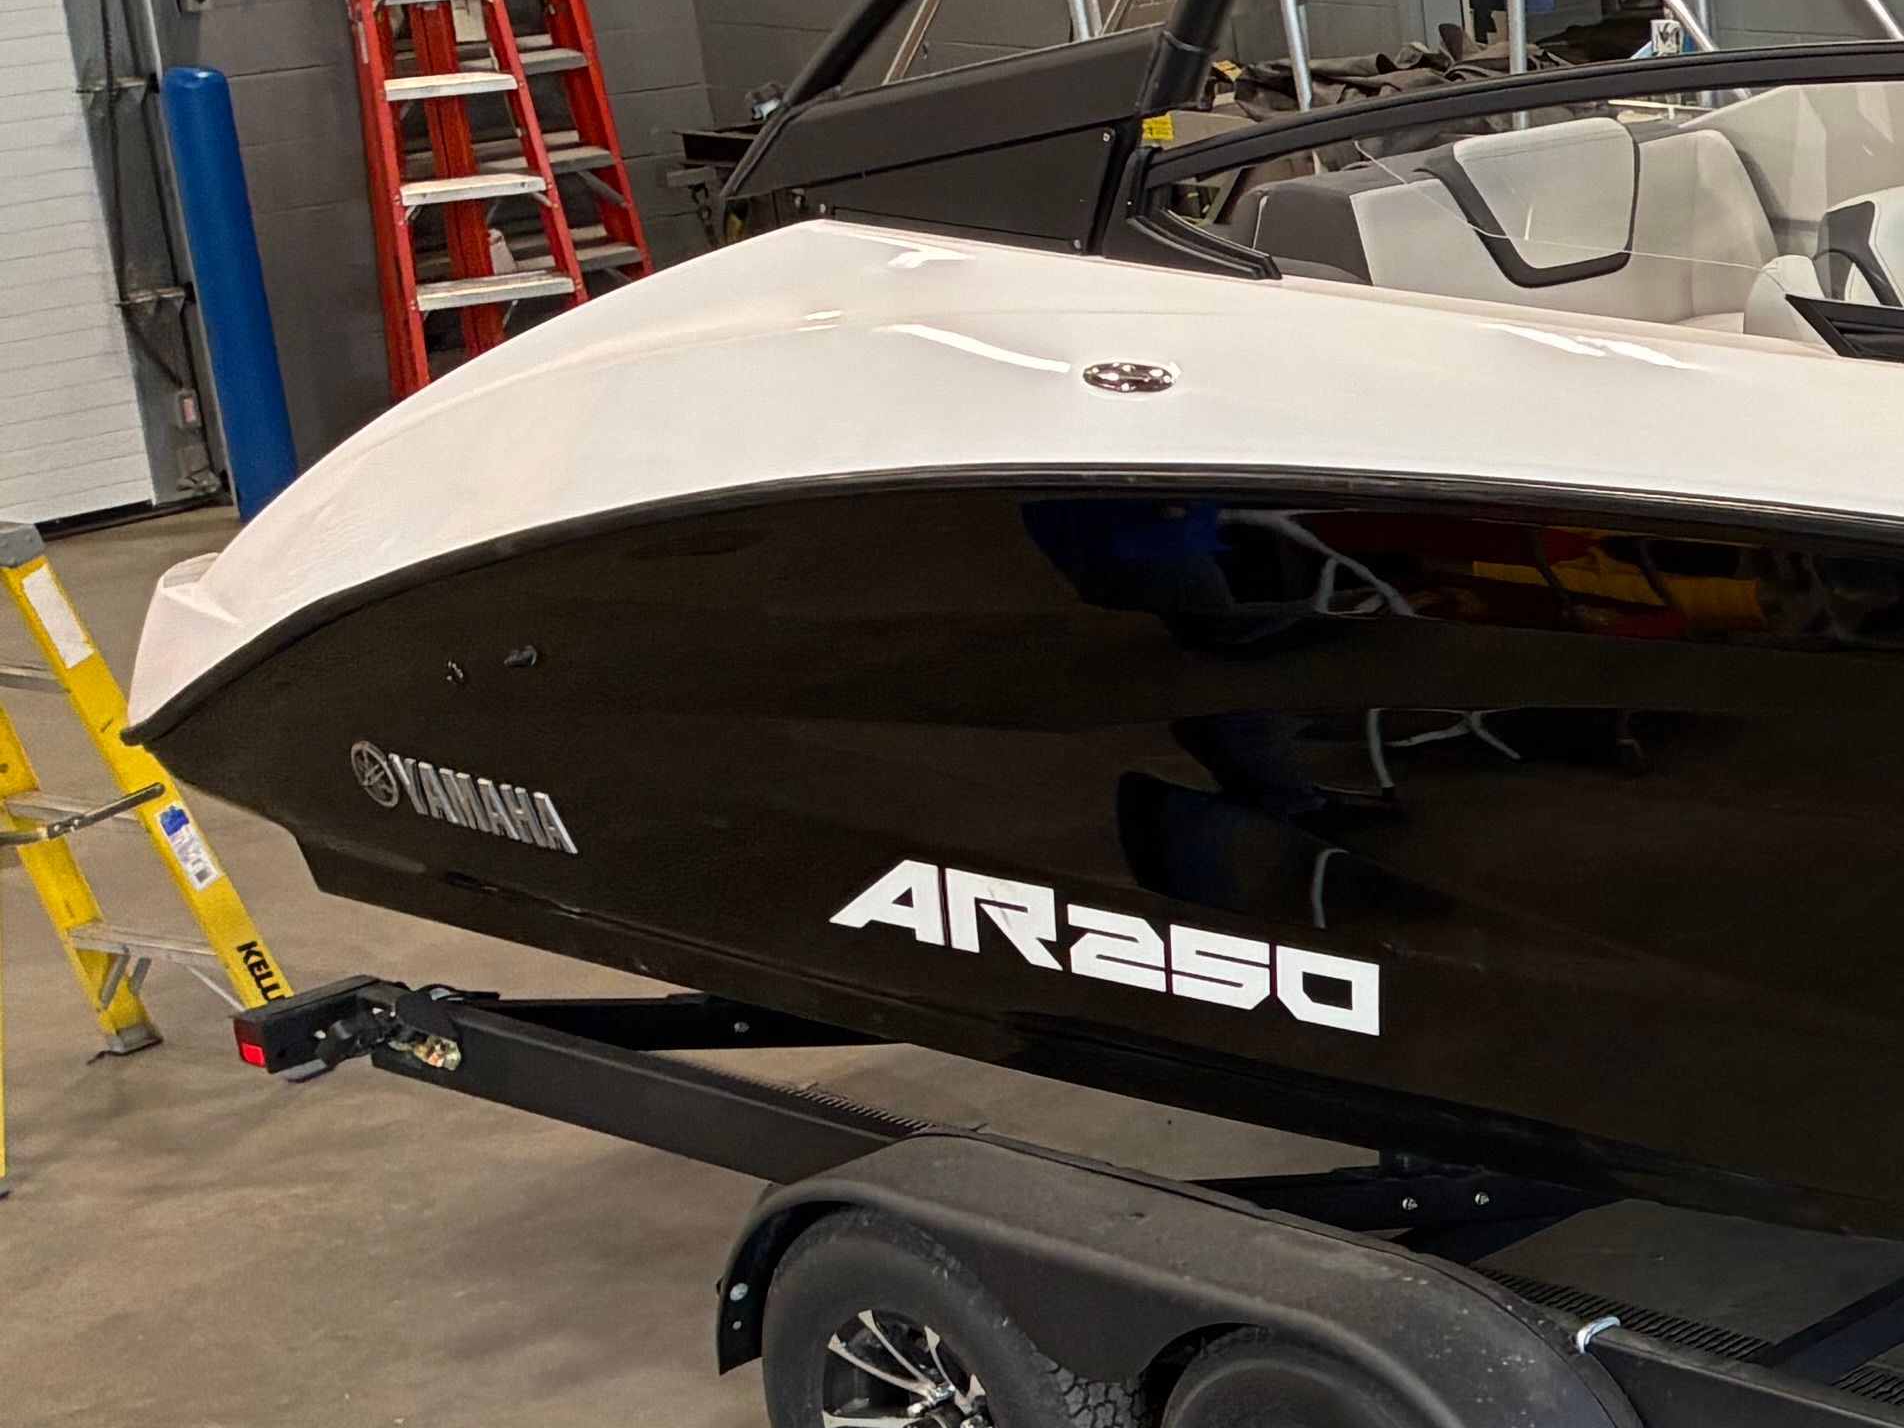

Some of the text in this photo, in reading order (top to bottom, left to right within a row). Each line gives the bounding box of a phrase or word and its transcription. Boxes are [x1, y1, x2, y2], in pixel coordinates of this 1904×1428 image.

[388, 753, 578, 854] YAMAHA
[236, 941, 286, 1003] KELL
[829, 859, 1380, 1036] AR250
